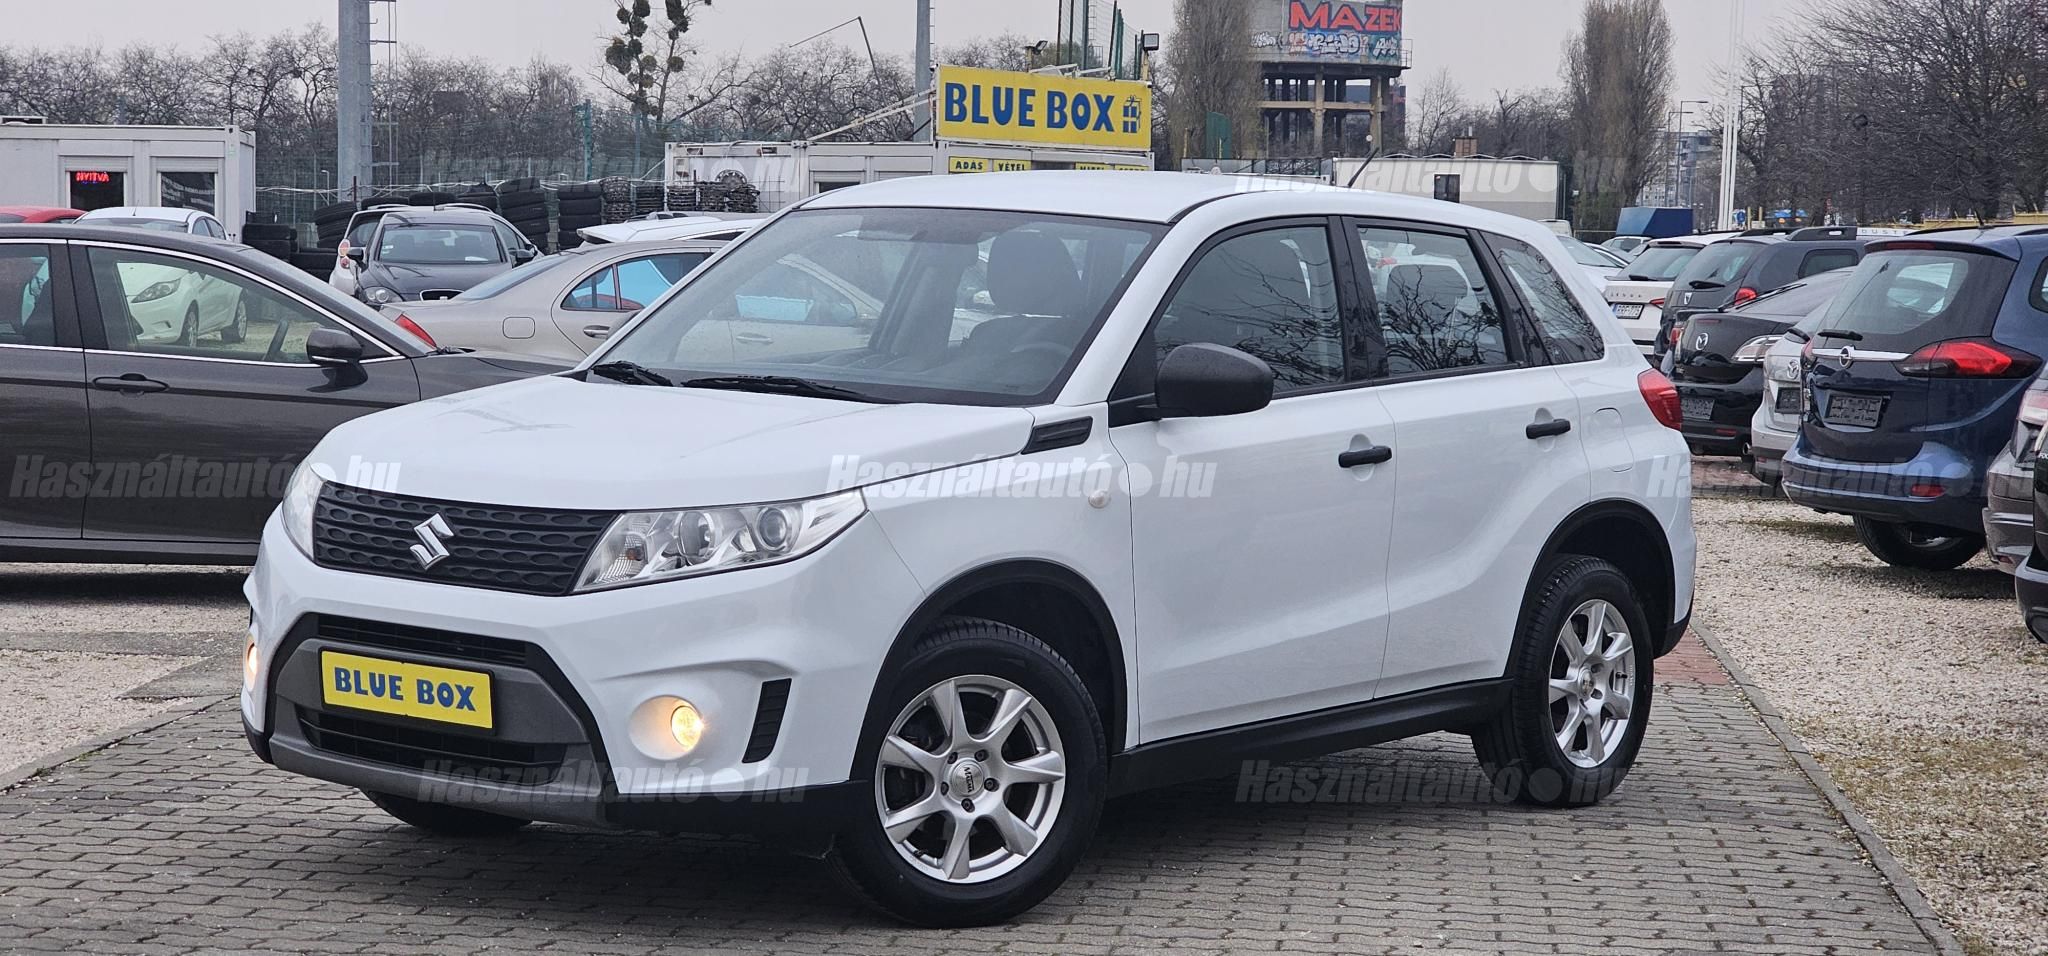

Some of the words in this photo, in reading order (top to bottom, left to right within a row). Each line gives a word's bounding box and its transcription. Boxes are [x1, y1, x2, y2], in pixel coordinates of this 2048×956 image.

[945, 82, 1036, 127] BLUE
[1047, 90, 1115, 133] BOX
[955, 159, 983, 170] ADÁS
[334, 666, 404, 701] BLUE
[416, 678, 476, 712] BOX
